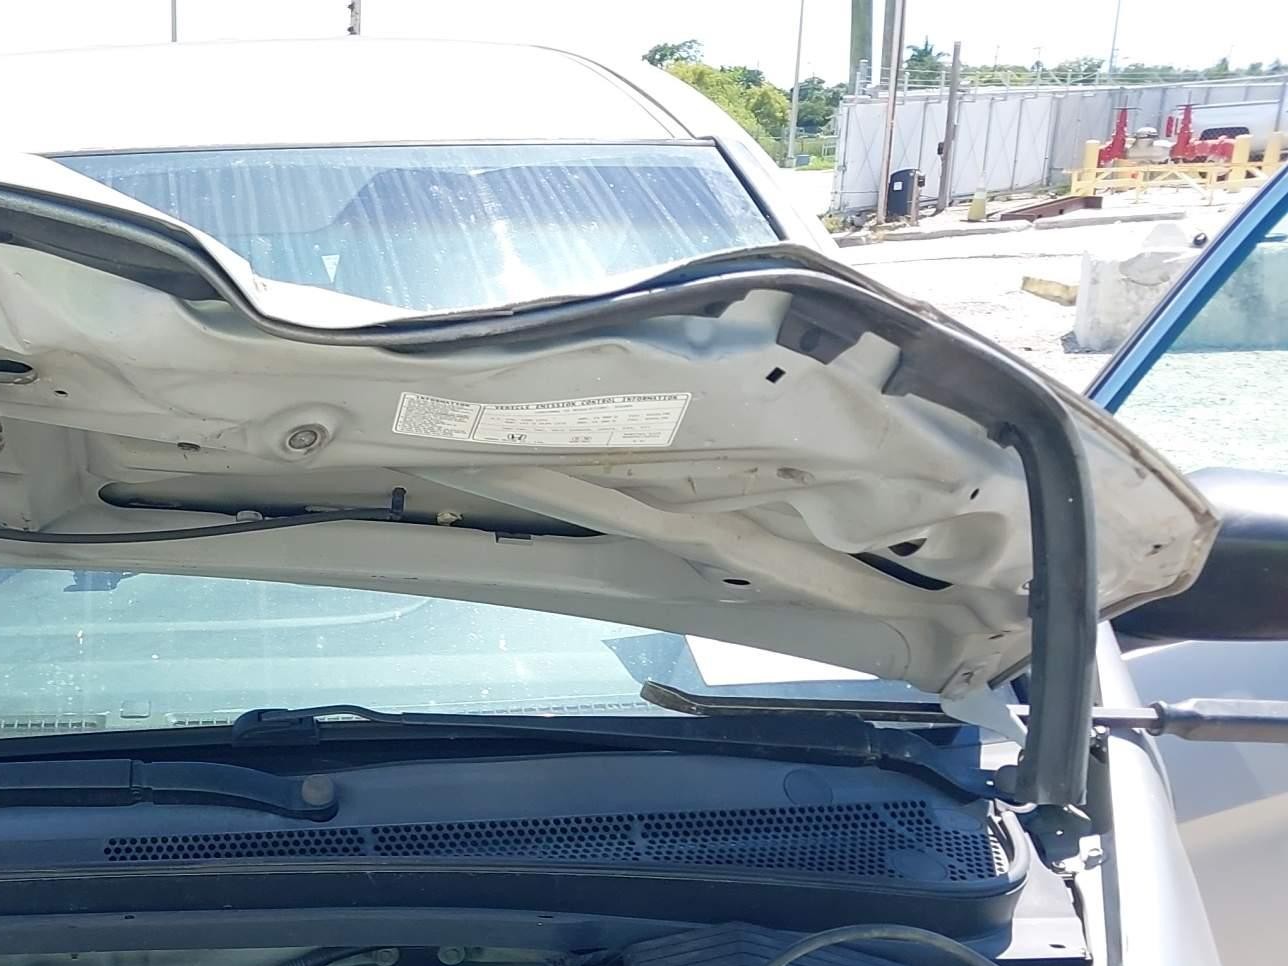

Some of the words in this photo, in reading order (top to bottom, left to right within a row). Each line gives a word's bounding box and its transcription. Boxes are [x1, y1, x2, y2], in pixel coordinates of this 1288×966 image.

[535, 400, 577, 409] EMISSION
[581, 397, 616, 406] CONTROL
[622, 394, 679, 403] INFORMATION
